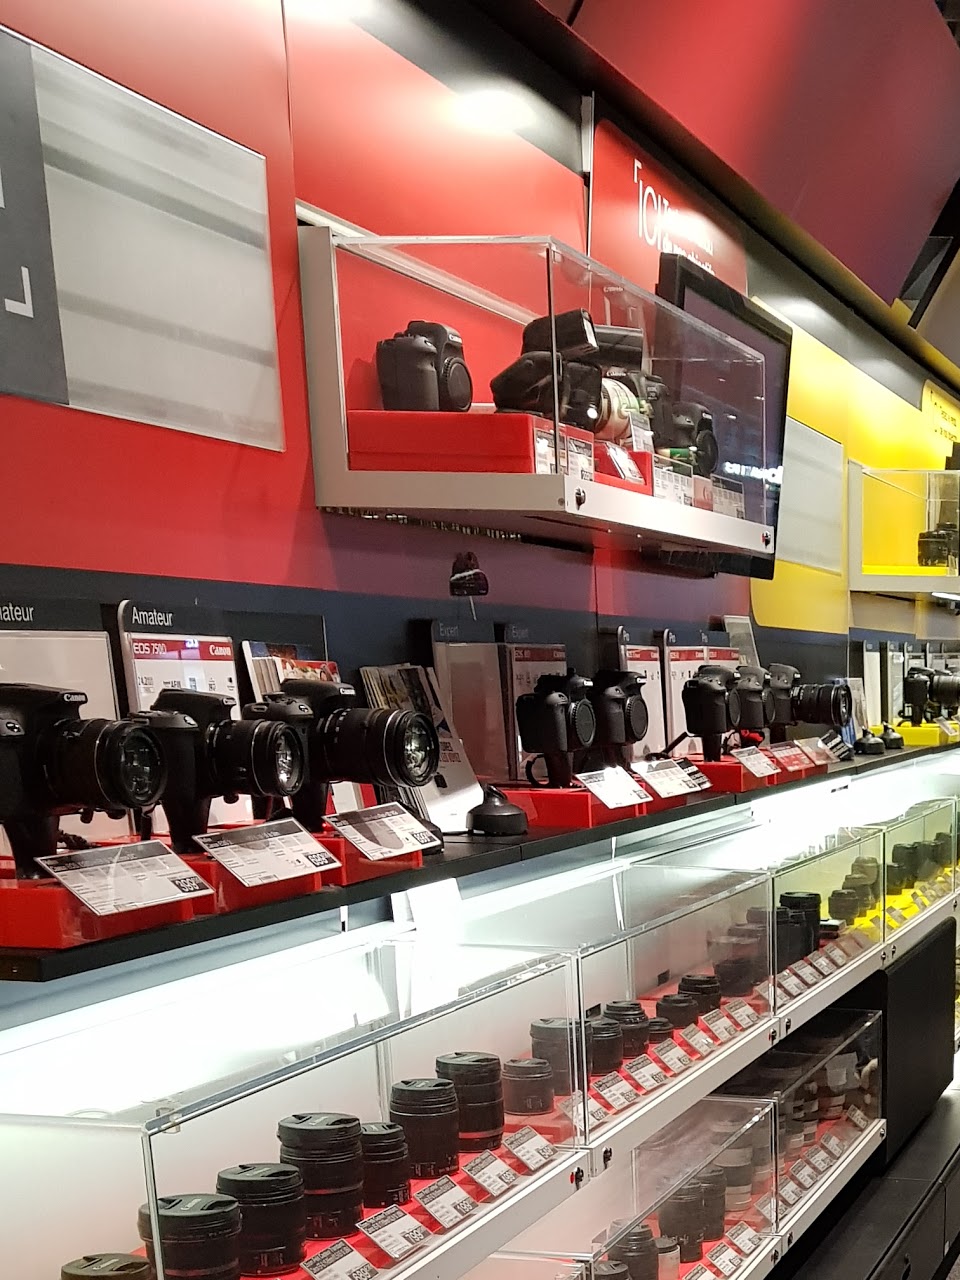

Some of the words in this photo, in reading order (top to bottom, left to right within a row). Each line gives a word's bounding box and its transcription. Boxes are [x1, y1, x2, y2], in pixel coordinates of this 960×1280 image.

[0, 602, 34, 621] ateur
[132, 606, 173, 626] Amateur
[133, 643, 150, 654] EOS
[209, 645, 231, 655] Canon
